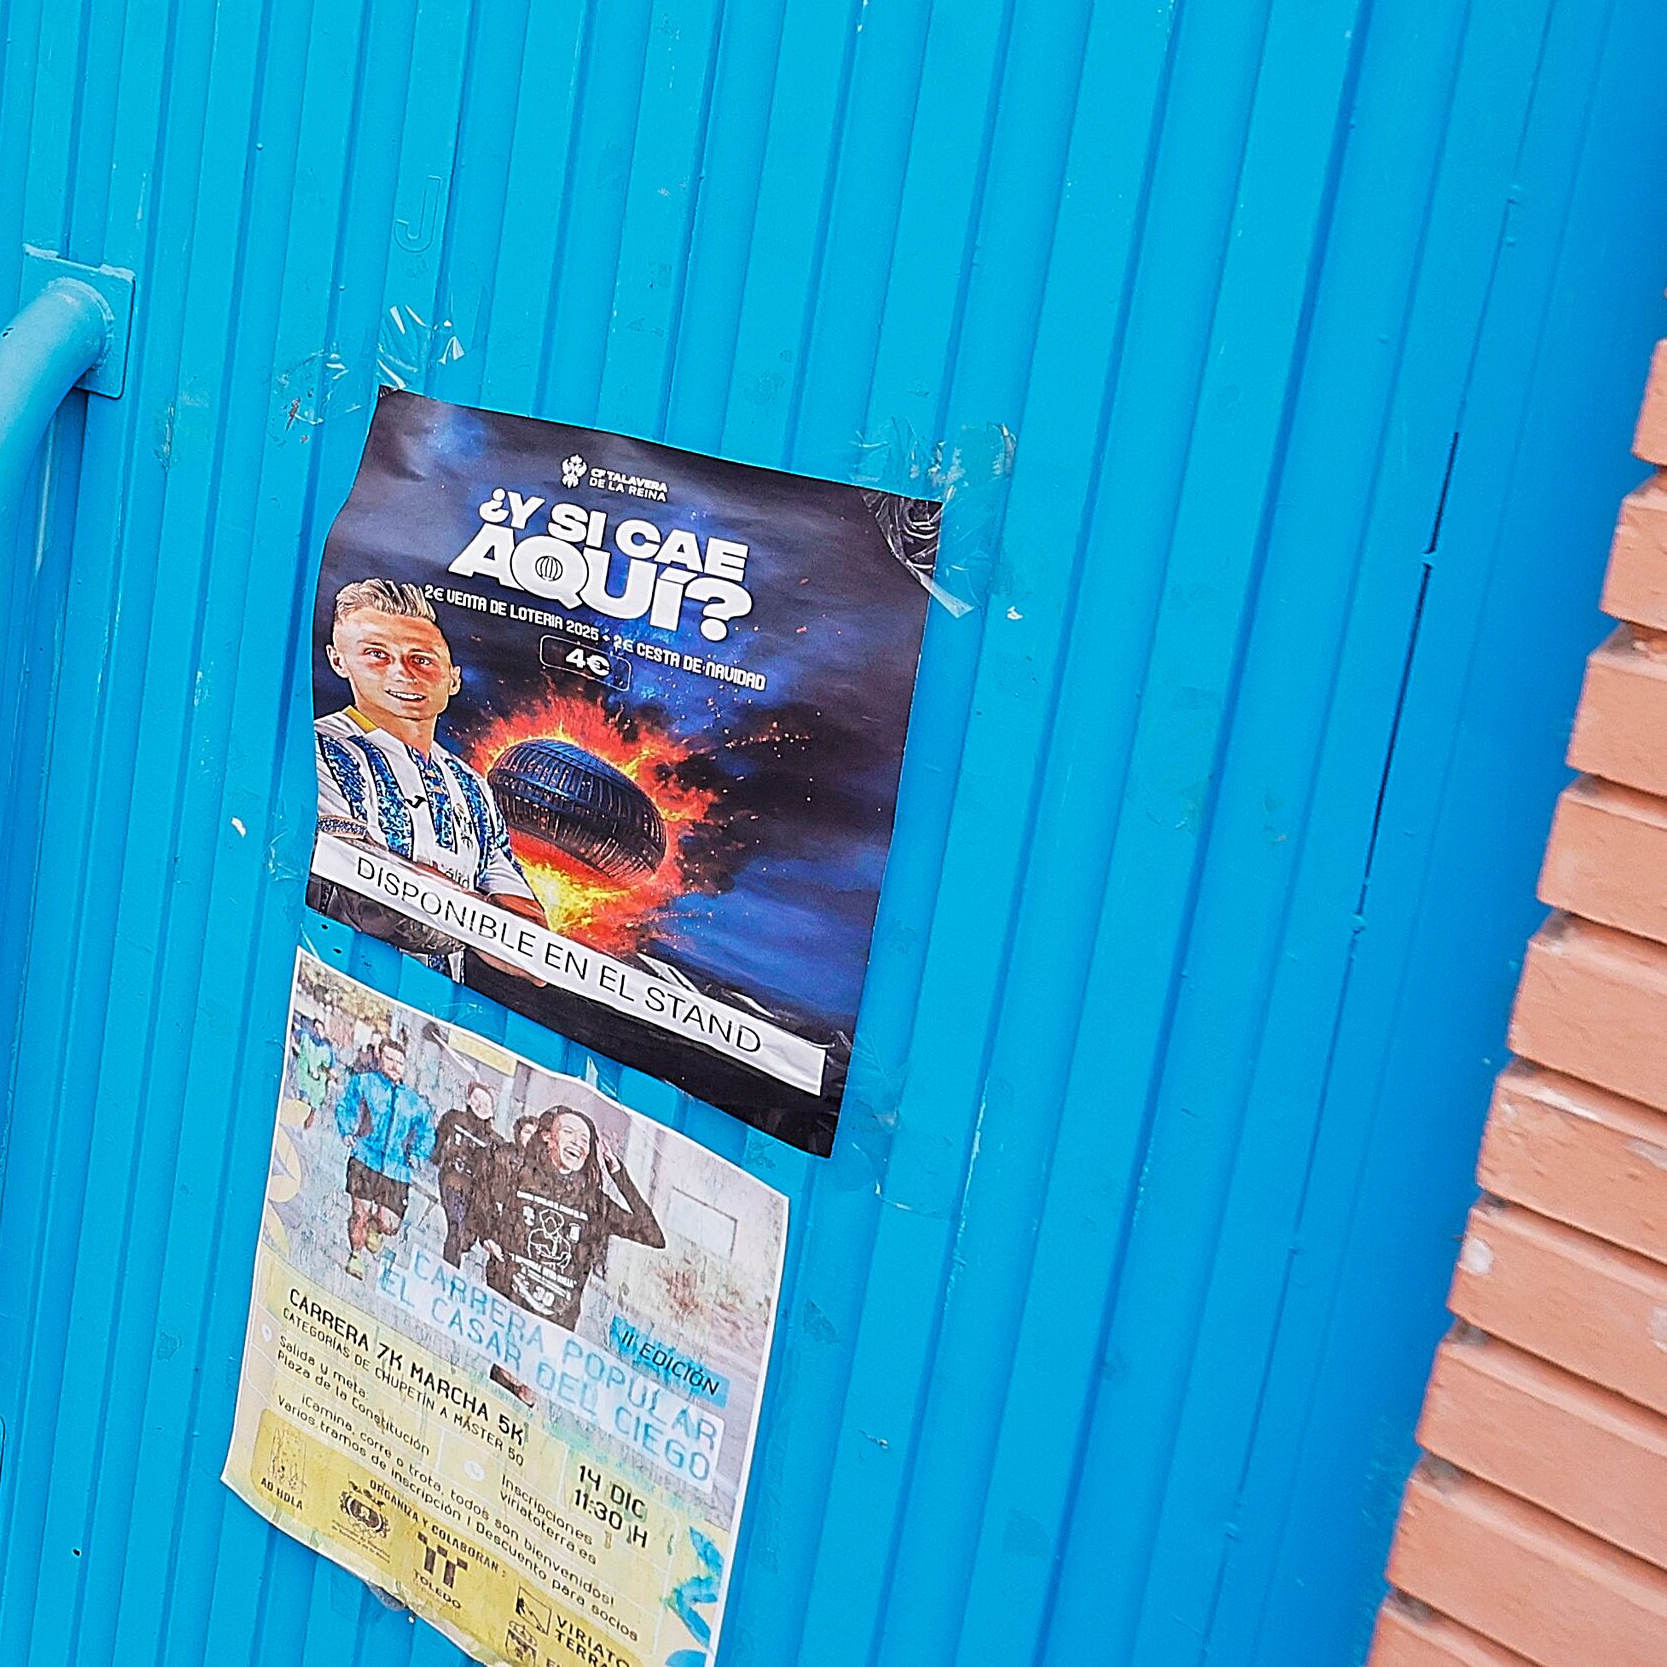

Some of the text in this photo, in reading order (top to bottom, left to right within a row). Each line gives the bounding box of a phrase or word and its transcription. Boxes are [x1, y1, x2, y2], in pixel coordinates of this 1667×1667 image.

[589, 477, 667, 502] DE LA REINA
[590, 468, 668, 493] CF TALAVERA
[479, 488, 749, 582] ¿Y SI CAE
[447, 523, 753, 641] AQUÍ?
[424, 585, 445, 602] 2€
[446, 589, 487, 611] VENTA
[489, 600, 507, 616] DE
[510, 604, 564, 630] LOTERIA
[566, 620, 599, 641] 2025
[613, 635, 634, 653] 2€
[636, 643, 679, 668] CESTA
[682, 655, 703, 674] DE
[706, 662, 766, 691] NAVIDAD
[566, 649, 610, 677] 4€
[356, 856, 763, 1054] DISPONIBLE EN EL STAND
[279, 1335, 315, 1367] Salida
[319, 1360, 329, 1375] y
[282, 1307, 350, 1359] CATEGORÍAS
[354, 1354, 370, 1371] DE
[374, 1366, 436, 1411] CHUPETÍN
[440, 1406, 448, 1418] A
[454, 1413, 510, 1452] MÁSTER
[508, 1449, 524, 1467] 50
[288, 1288, 369, 1352] CARRERA
[376, 1342, 404, 1371] 7K
[410, 1361, 489, 1422] MARCHA
[498, 1413, 524, 1446] 5K
[379, 1265, 415, 1308] EL
[431, 1297, 522, 1372] CASAR
[536, 1362, 598, 1415] DEL
[615, 1406, 711, 1482] CIEGO
[413, 1251, 545, 1353] CARRERA
[562, 1337, 717, 1450] POPULAR
[620, 1330, 720, 1396] II EDICIÓN
[277, 1349, 431, 1456] Plaza de la Constitución
[278, 1395, 316, 1427] Varios
[320, 1423, 367, 1458] tramos
[371, 1453, 387, 1470] de
[391, 1468, 462, 1522] inscripción
[475, 1518, 547, 1581] Descuento
[552, 1578, 585, 1608] para
[591, 1602, 639, 1642] socios
[359, 1432, 393, 1459] corre
[396, 1458, 404, 1467] o
[408, 1464, 445, 1497] trota,
[450, 1488, 491, 1521] todos
[495, 1519, 519, 1542] son
[524, 1536, 614, 1607] bienvenidos!
[369, 1479, 419, 1523] ORGANIZA
[422, 1516, 429, 1528] Y
[431, 1524, 499, 1572] COLABORAN
[499, 1491, 597, 1566] viriatoterra.es
[501, 1474, 594, 1545] Inscripciones
[574, 1488, 648, 1549] 11:30 H
[578, 1464, 647, 1520] 14 DIC
[413, 1569, 462, 1609] TOLEDO
[556, 1614, 630, 1667] VIRIATO
